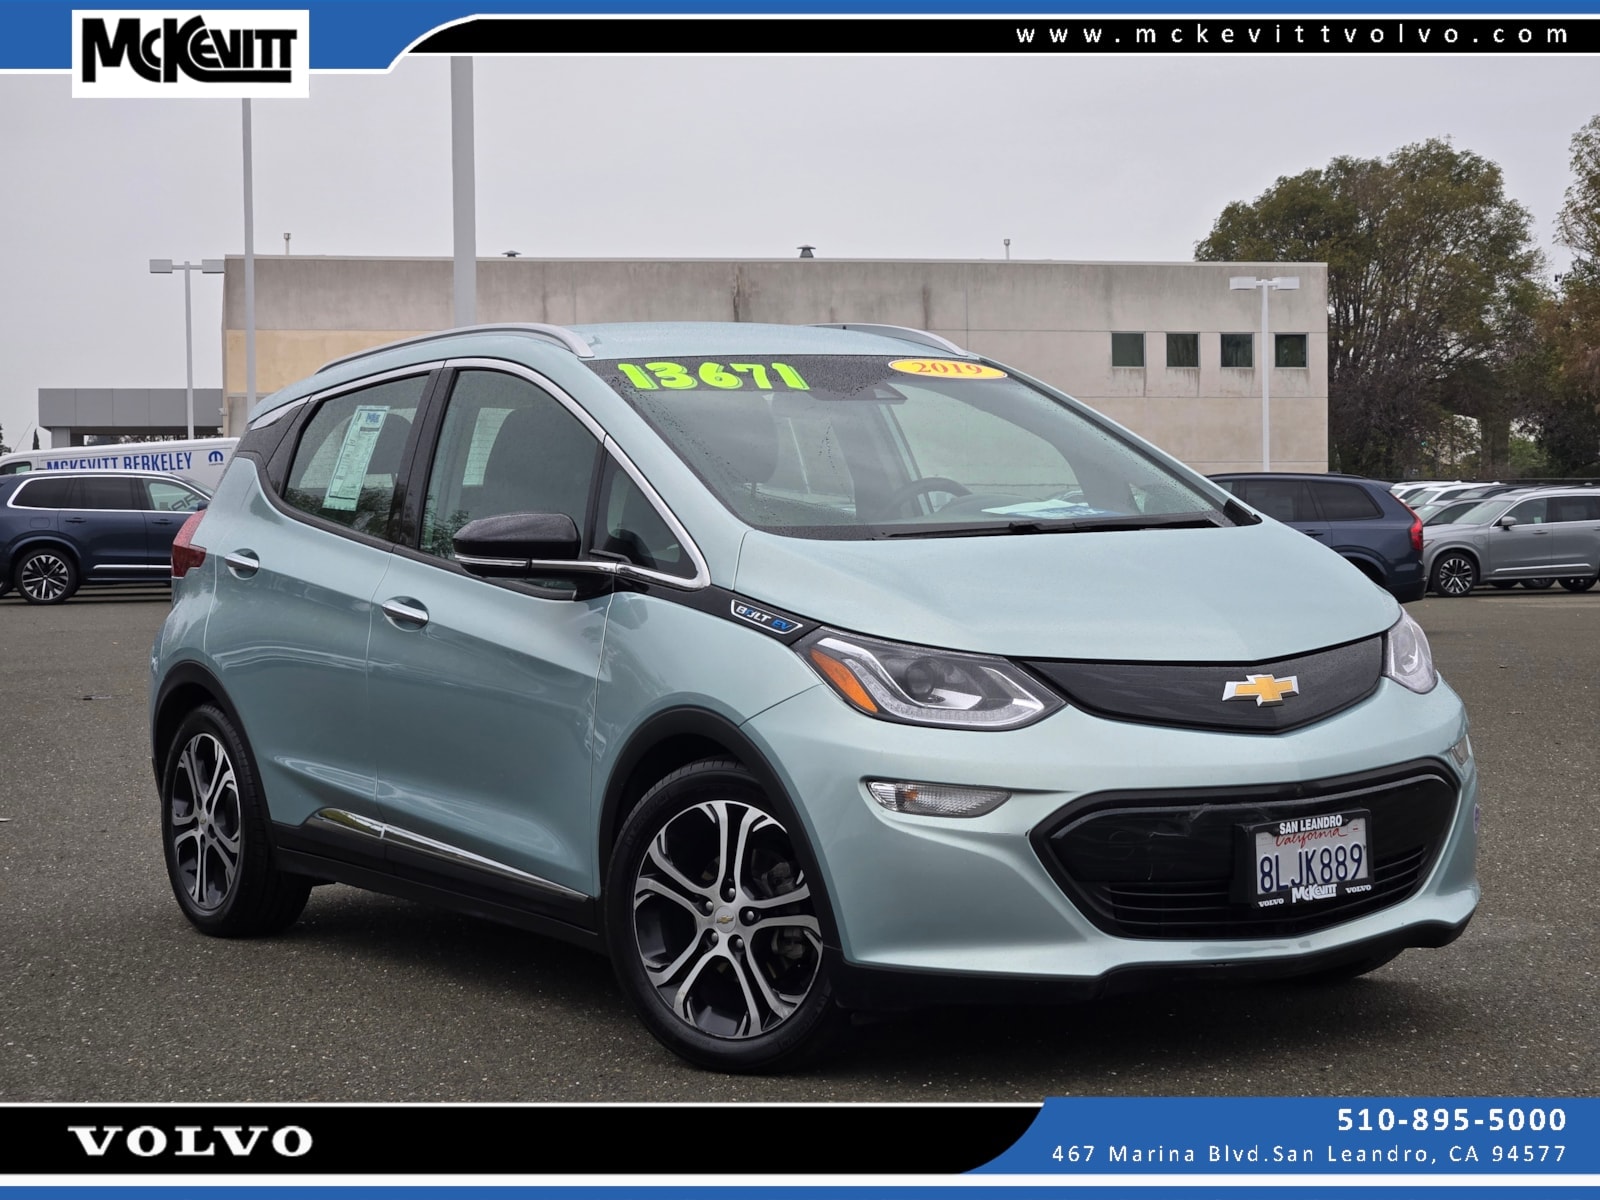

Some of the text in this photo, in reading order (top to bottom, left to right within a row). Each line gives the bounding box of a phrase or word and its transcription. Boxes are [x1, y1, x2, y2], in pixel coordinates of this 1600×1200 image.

[618, 361, 810, 391] 13671
[912, 362, 983, 375] 2019
[736, 605, 792, 630] BOLT EV
[1279, 814, 1342, 834] SAN LEANDRO
[1260, 843, 1363, 893] 8LJK889
[1258, 898, 1284, 907] VOLVO
[1345, 884, 1372, 893] VOLVO
